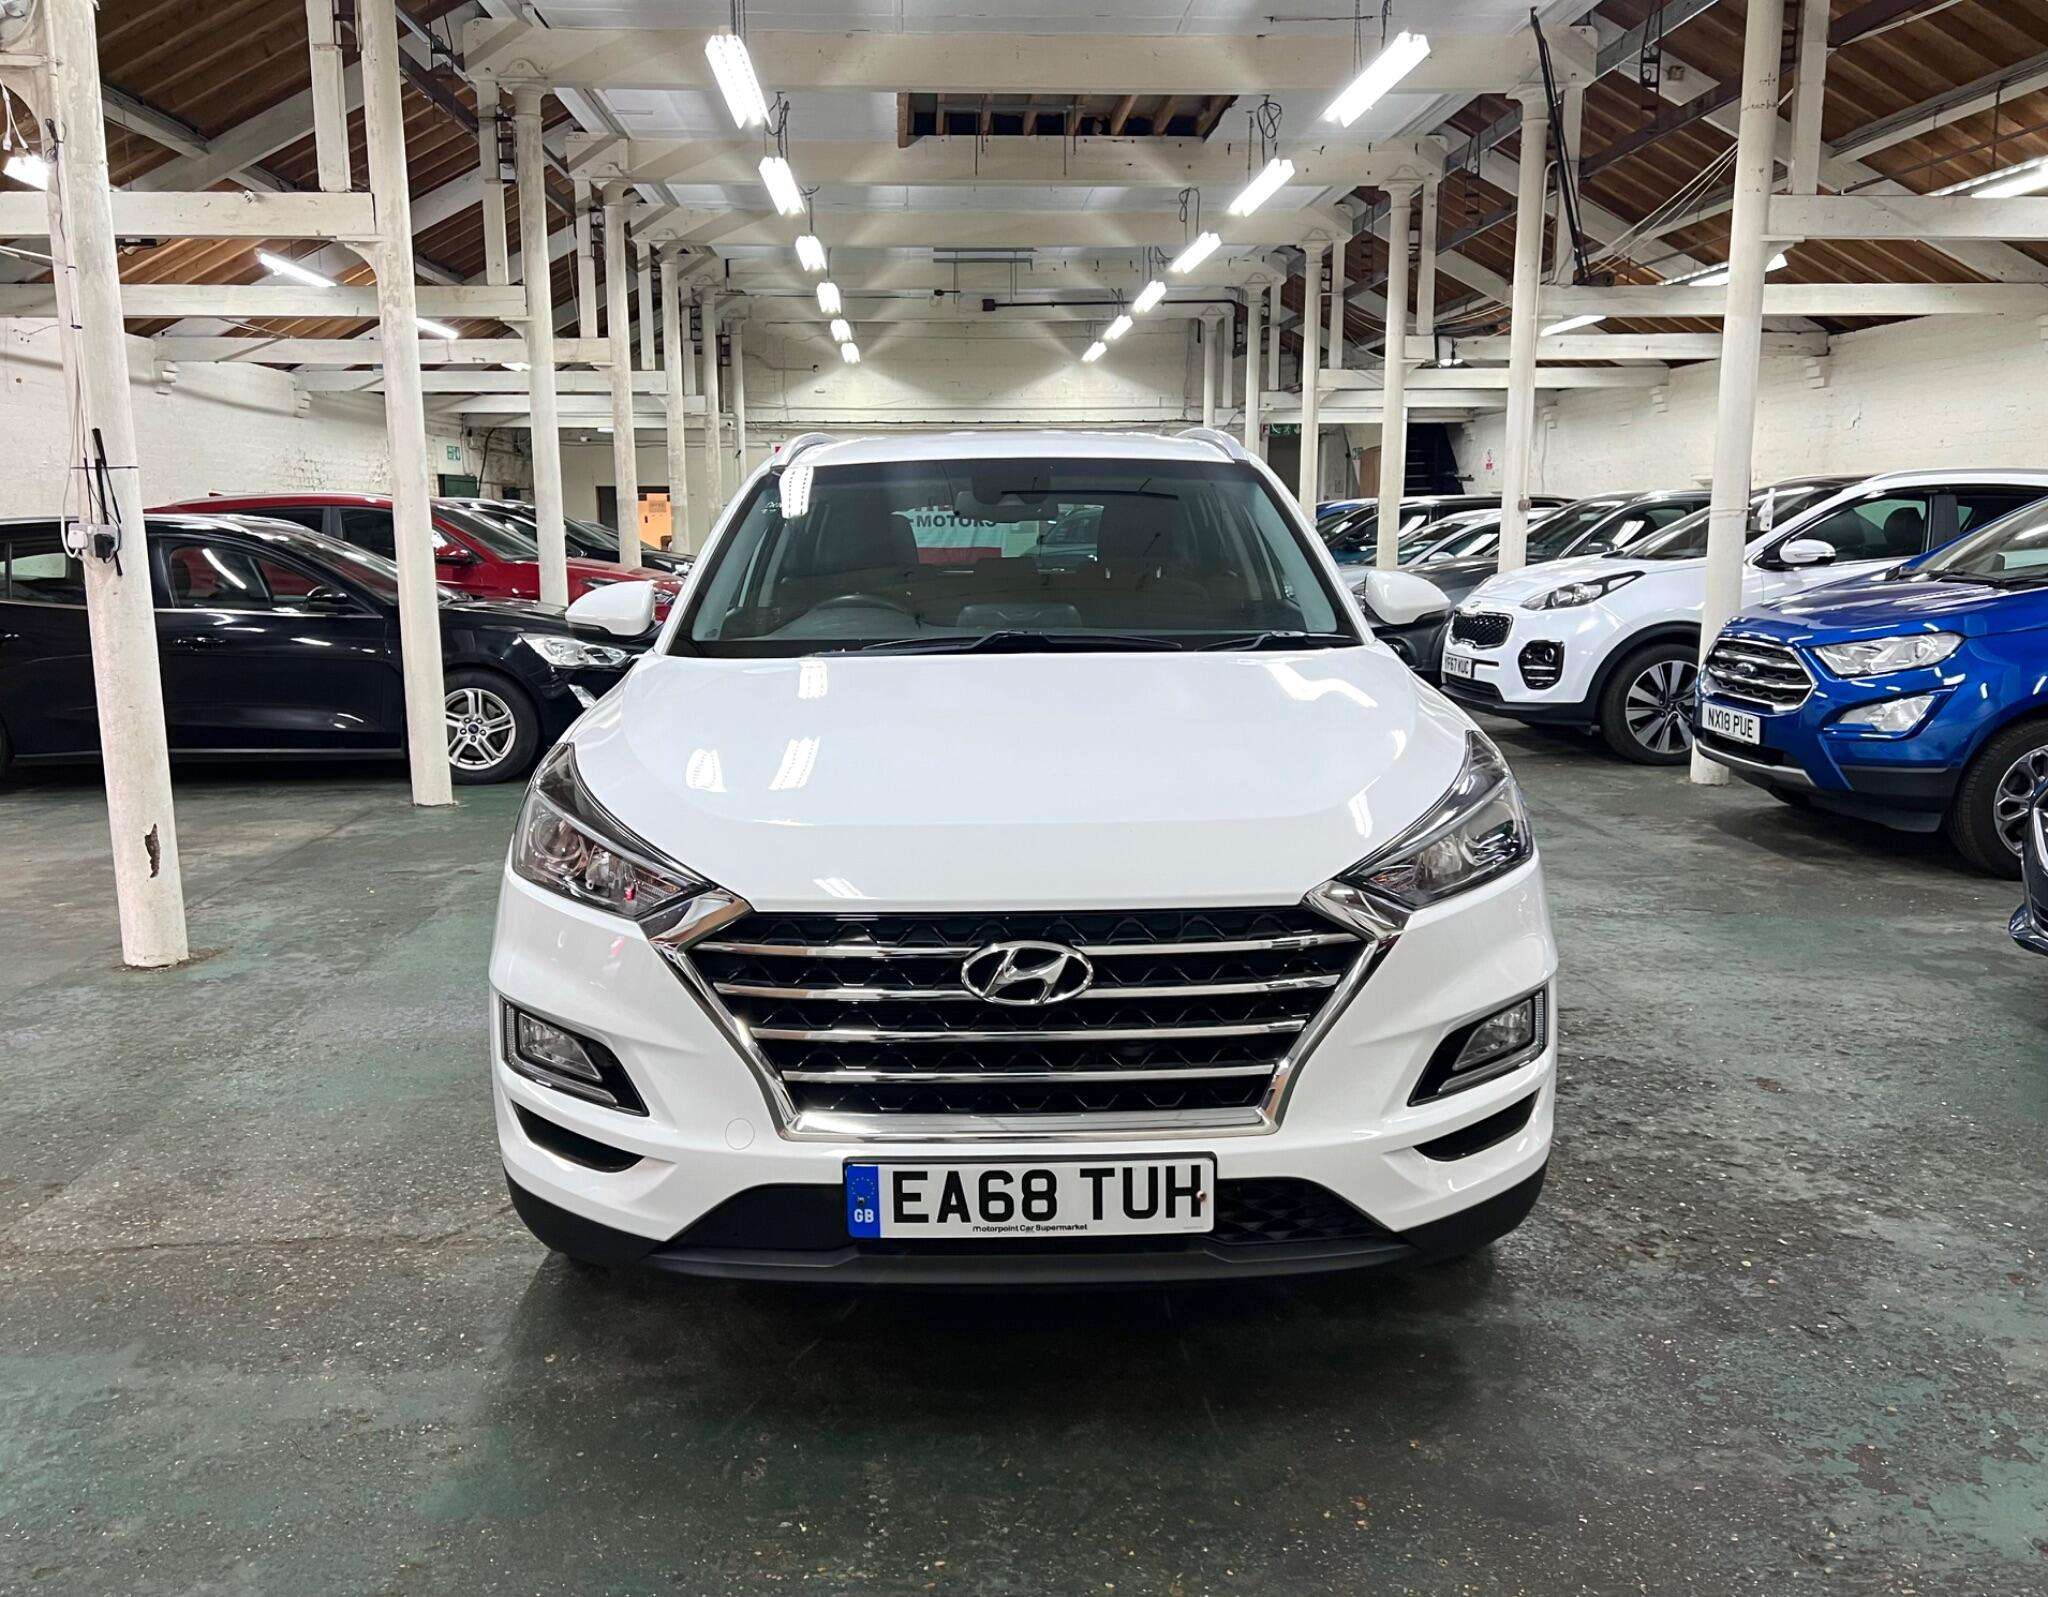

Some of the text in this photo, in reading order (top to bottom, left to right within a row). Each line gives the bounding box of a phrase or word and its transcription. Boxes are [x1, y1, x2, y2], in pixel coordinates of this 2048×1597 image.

[1733, 714, 1754, 738] PUE
[892, 1164, 1200, 1224] EA68 TUH
[853, 1208, 875, 1224] GB
[1035, 1223, 1088, 1233] Supermarket
